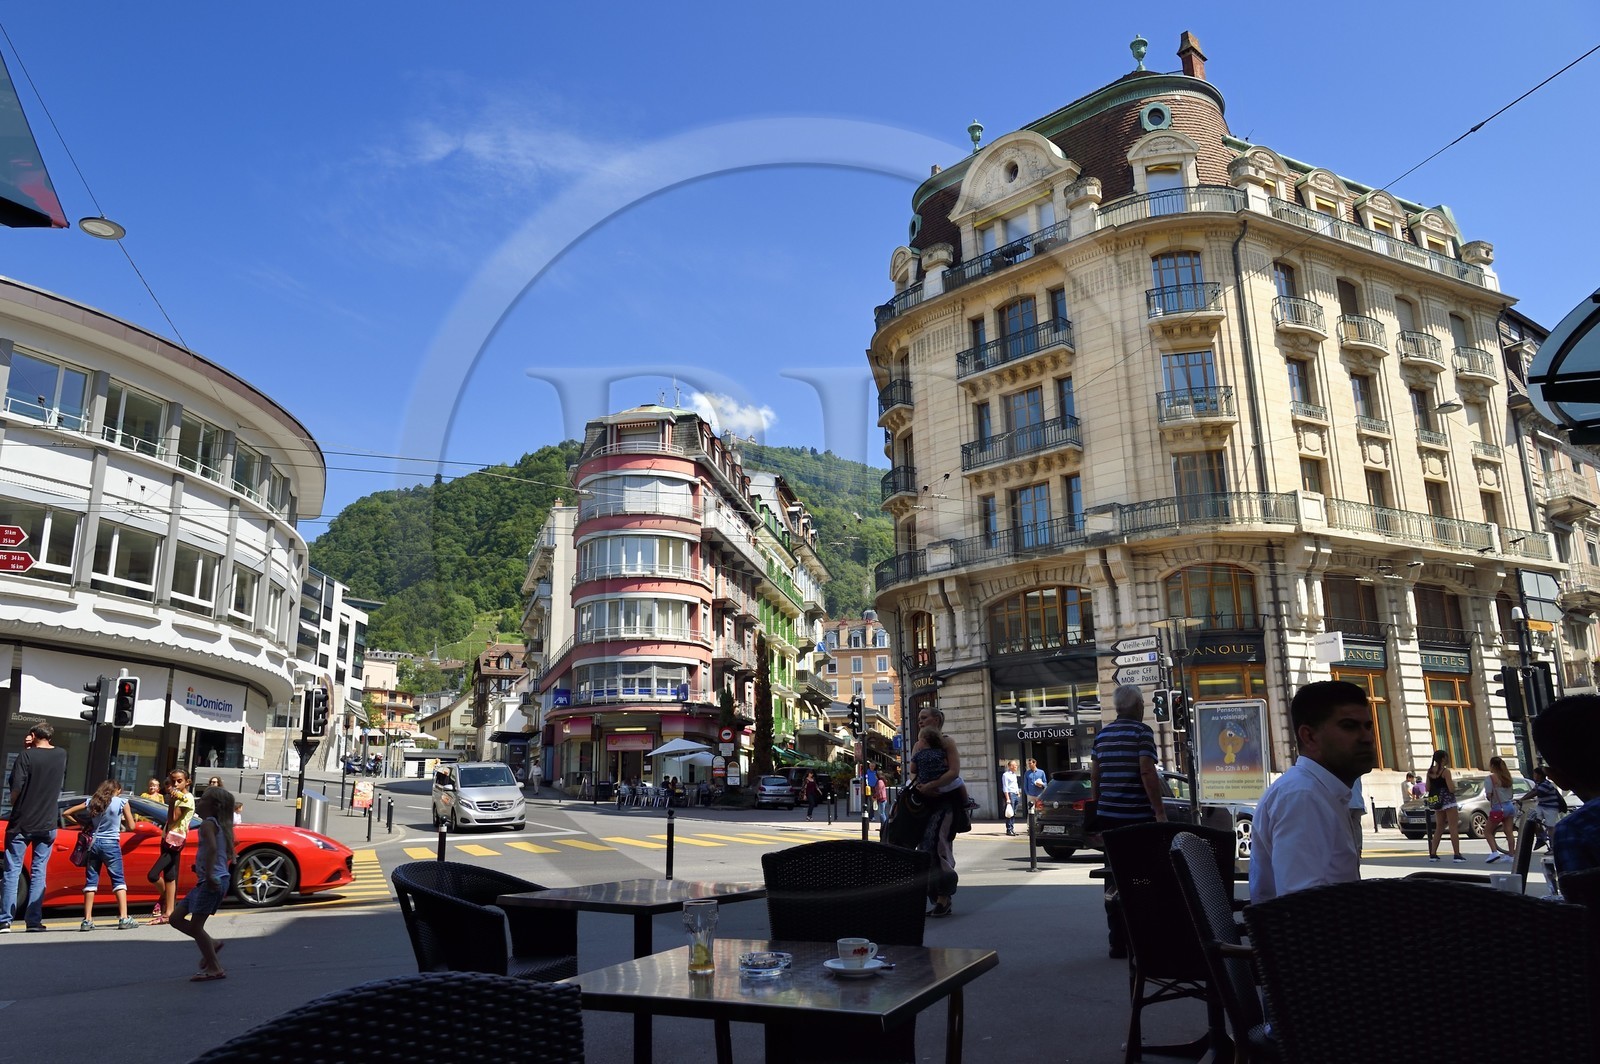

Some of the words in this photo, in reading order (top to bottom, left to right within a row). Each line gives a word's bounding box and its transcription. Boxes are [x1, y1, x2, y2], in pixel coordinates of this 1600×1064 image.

[1122, 639, 1155, 650] Vieille-ville
[1420, 654, 1465, 666] TITRES
[196, 694, 233, 713] Domicim
[554, 696, 569, 704] AXA
[17, 714, 47, 723] Domicim
[1017, 730, 1047, 740] CREDIT
[1047, 728, 1074, 738] SUISSE
